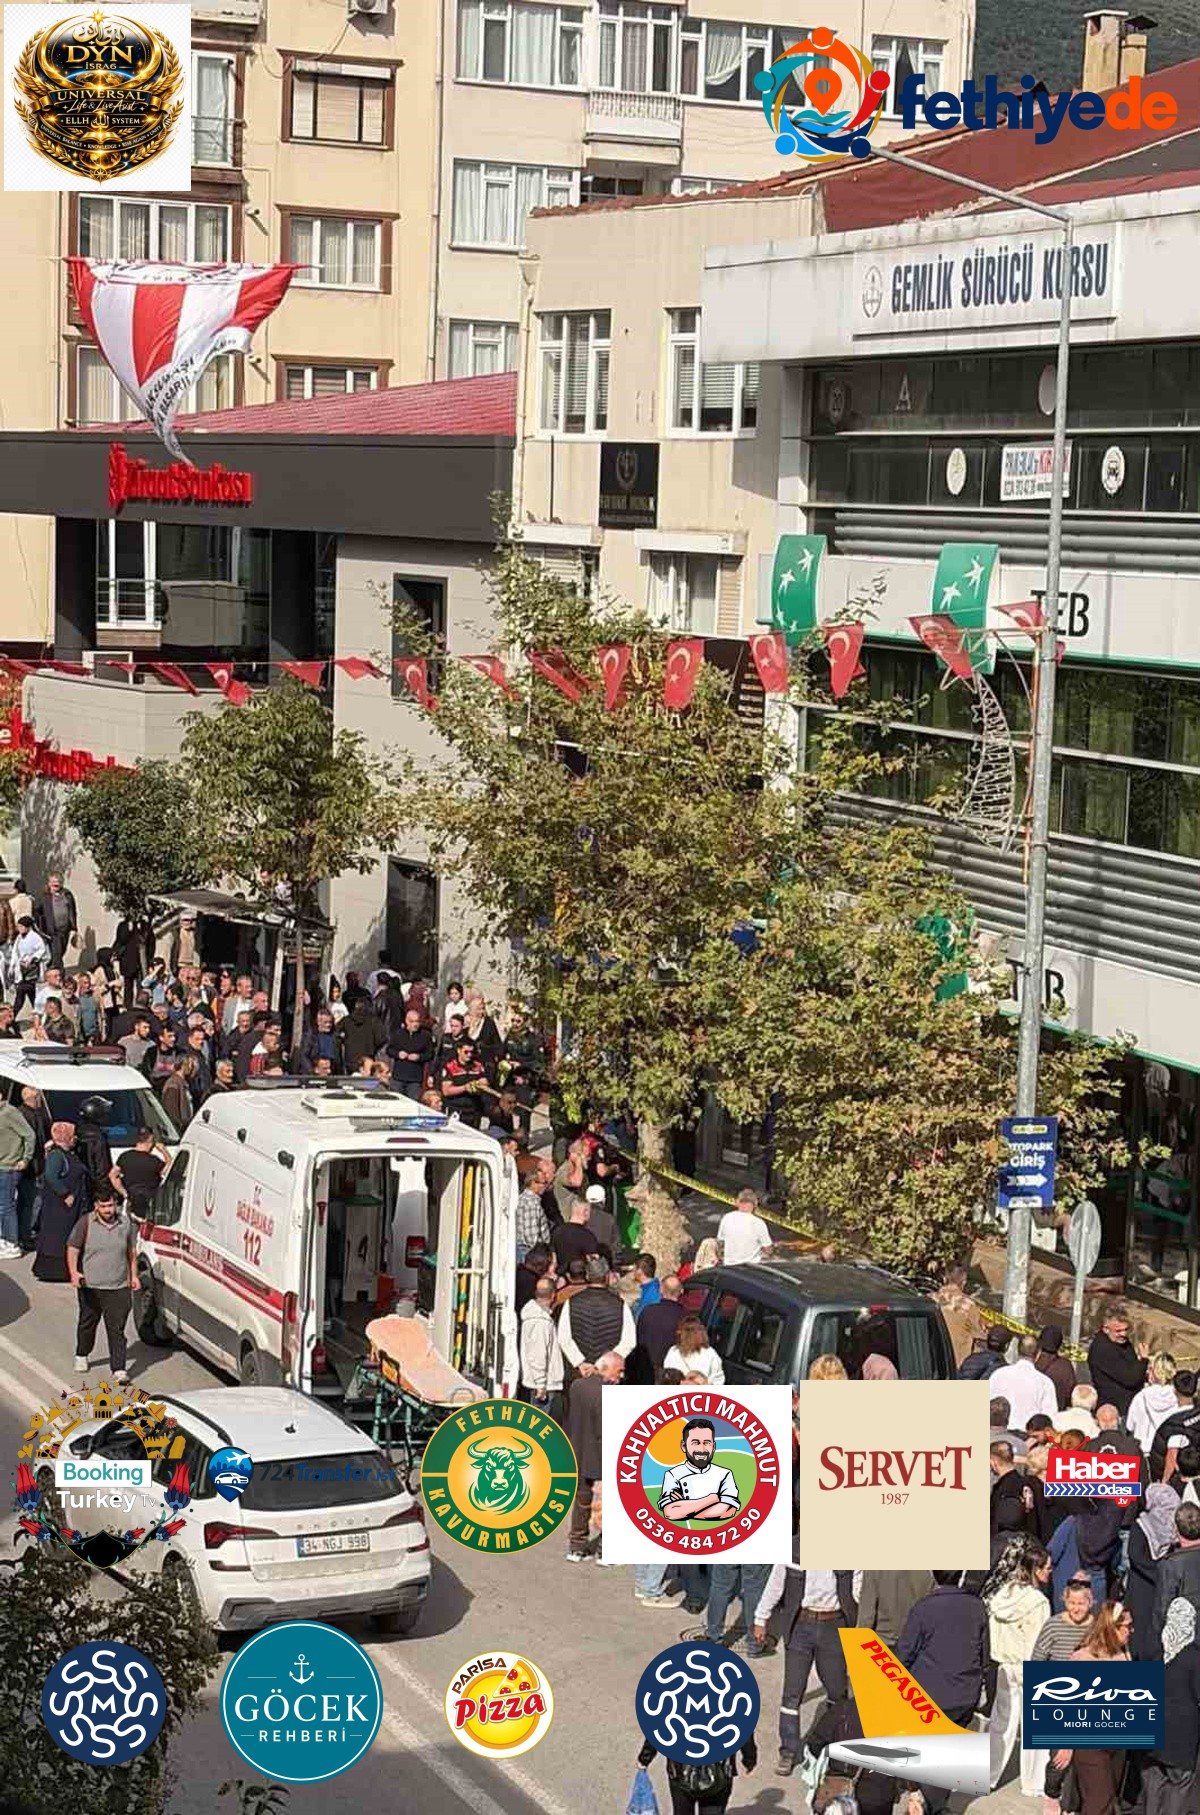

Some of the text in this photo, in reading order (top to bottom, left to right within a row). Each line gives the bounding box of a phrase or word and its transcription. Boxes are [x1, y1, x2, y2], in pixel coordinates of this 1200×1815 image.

[892, 254, 954, 314] GEMLİK
[961, 243, 1034, 308] SÜRÜCÜ
[1005, 957, 1066, 1013] TB
[1003, 1142, 1054, 1152] TOPARK
[243, 1228, 262, 1267] 112
[304, 1539, 318, 1551] 34
